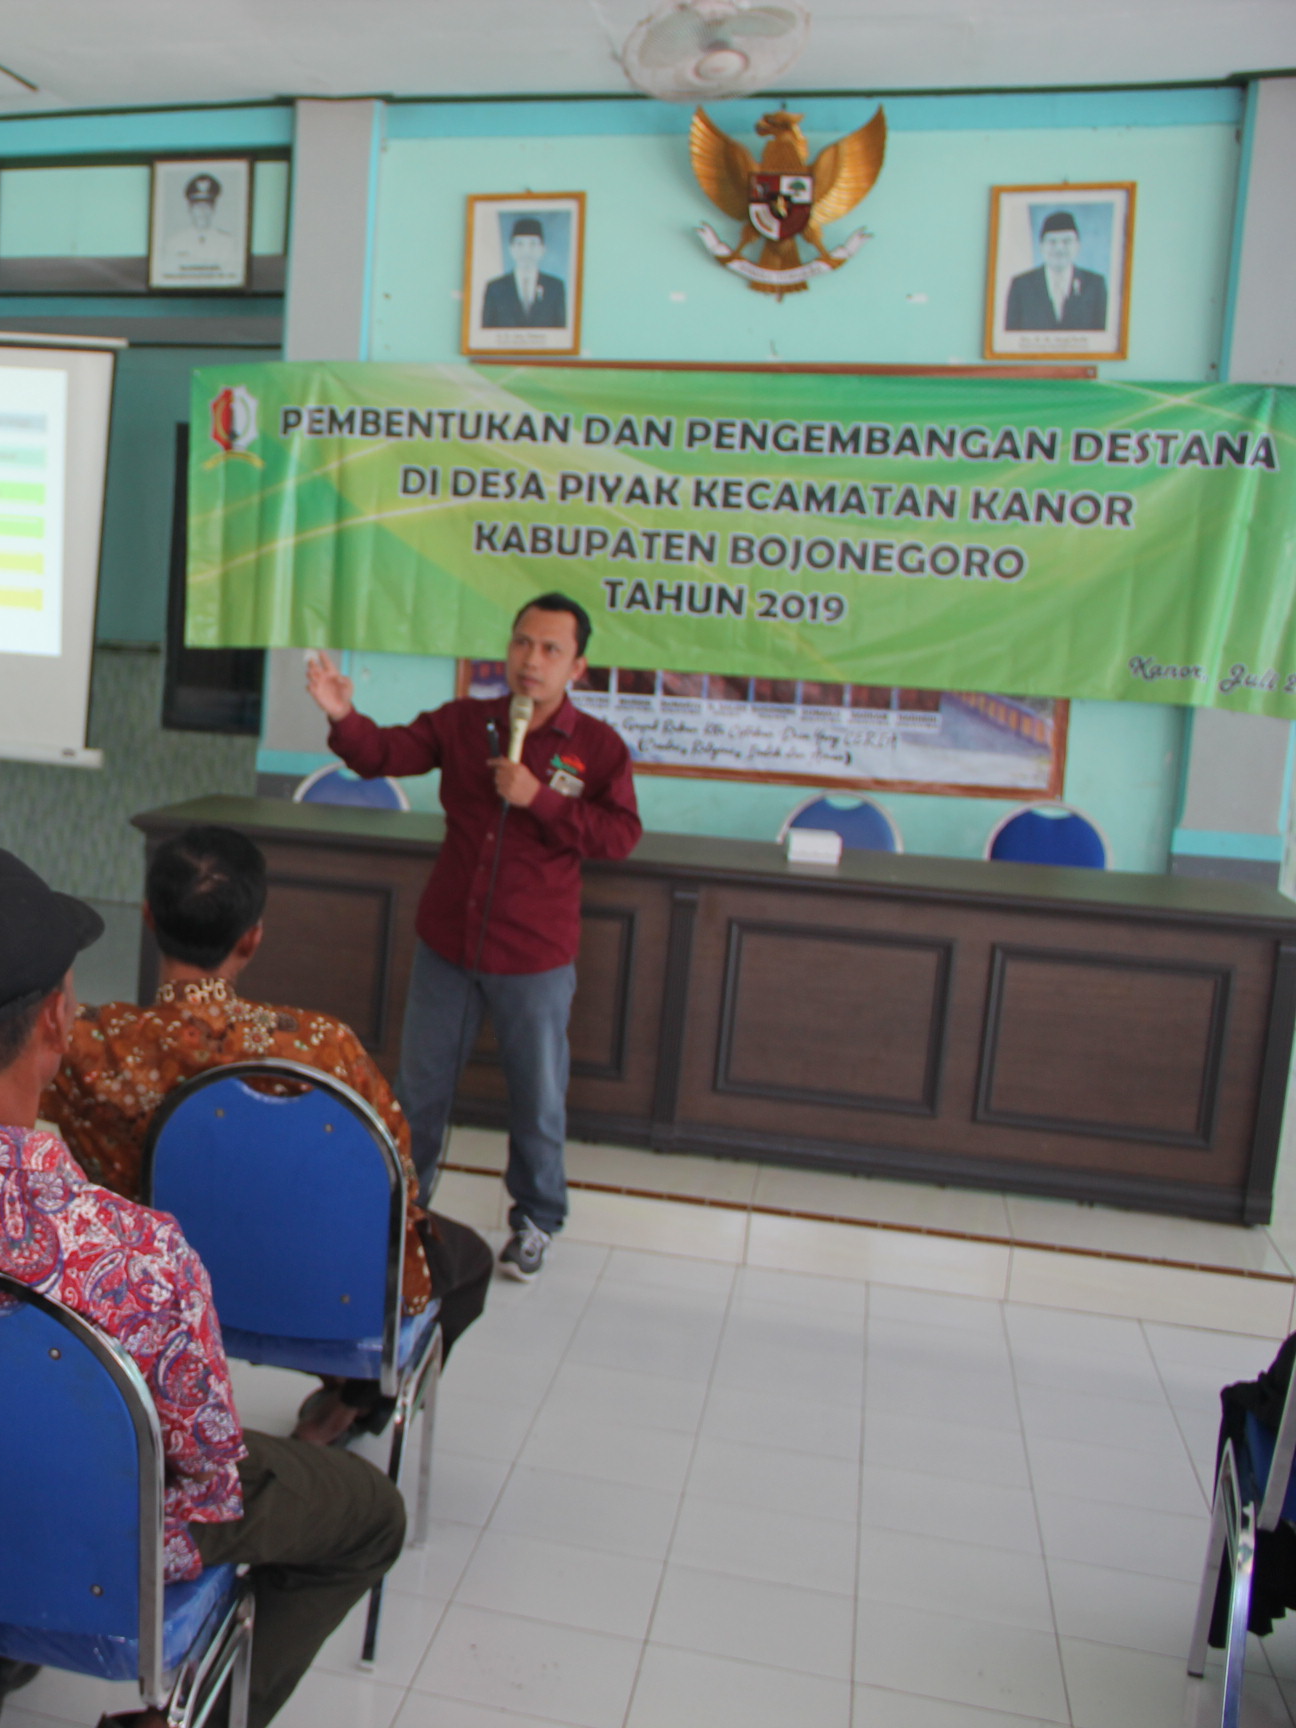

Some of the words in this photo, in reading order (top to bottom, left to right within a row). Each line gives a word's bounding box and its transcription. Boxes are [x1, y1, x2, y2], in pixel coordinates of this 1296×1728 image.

[281, 407, 571, 445] PEMBENTUKAN
[584, 416, 672, 450] DAN
[687, 419, 1057, 463] PENGEMBANGAN
[1072, 430, 1279, 471] DESTANA
[401, 466, 439, 497] DI
[450, 468, 546, 501] DESA
[559, 472, 681, 508] PIYAK
[693, 479, 956, 520] KECAMATAN
[971, 487, 1133, 528] KANOR
[474, 522, 716, 563] KABUPATEN
[730, 534, 1025, 580] BOJONEGORO
[604, 579, 746, 619] TAHUN
[758, 591, 846, 624] 2019
